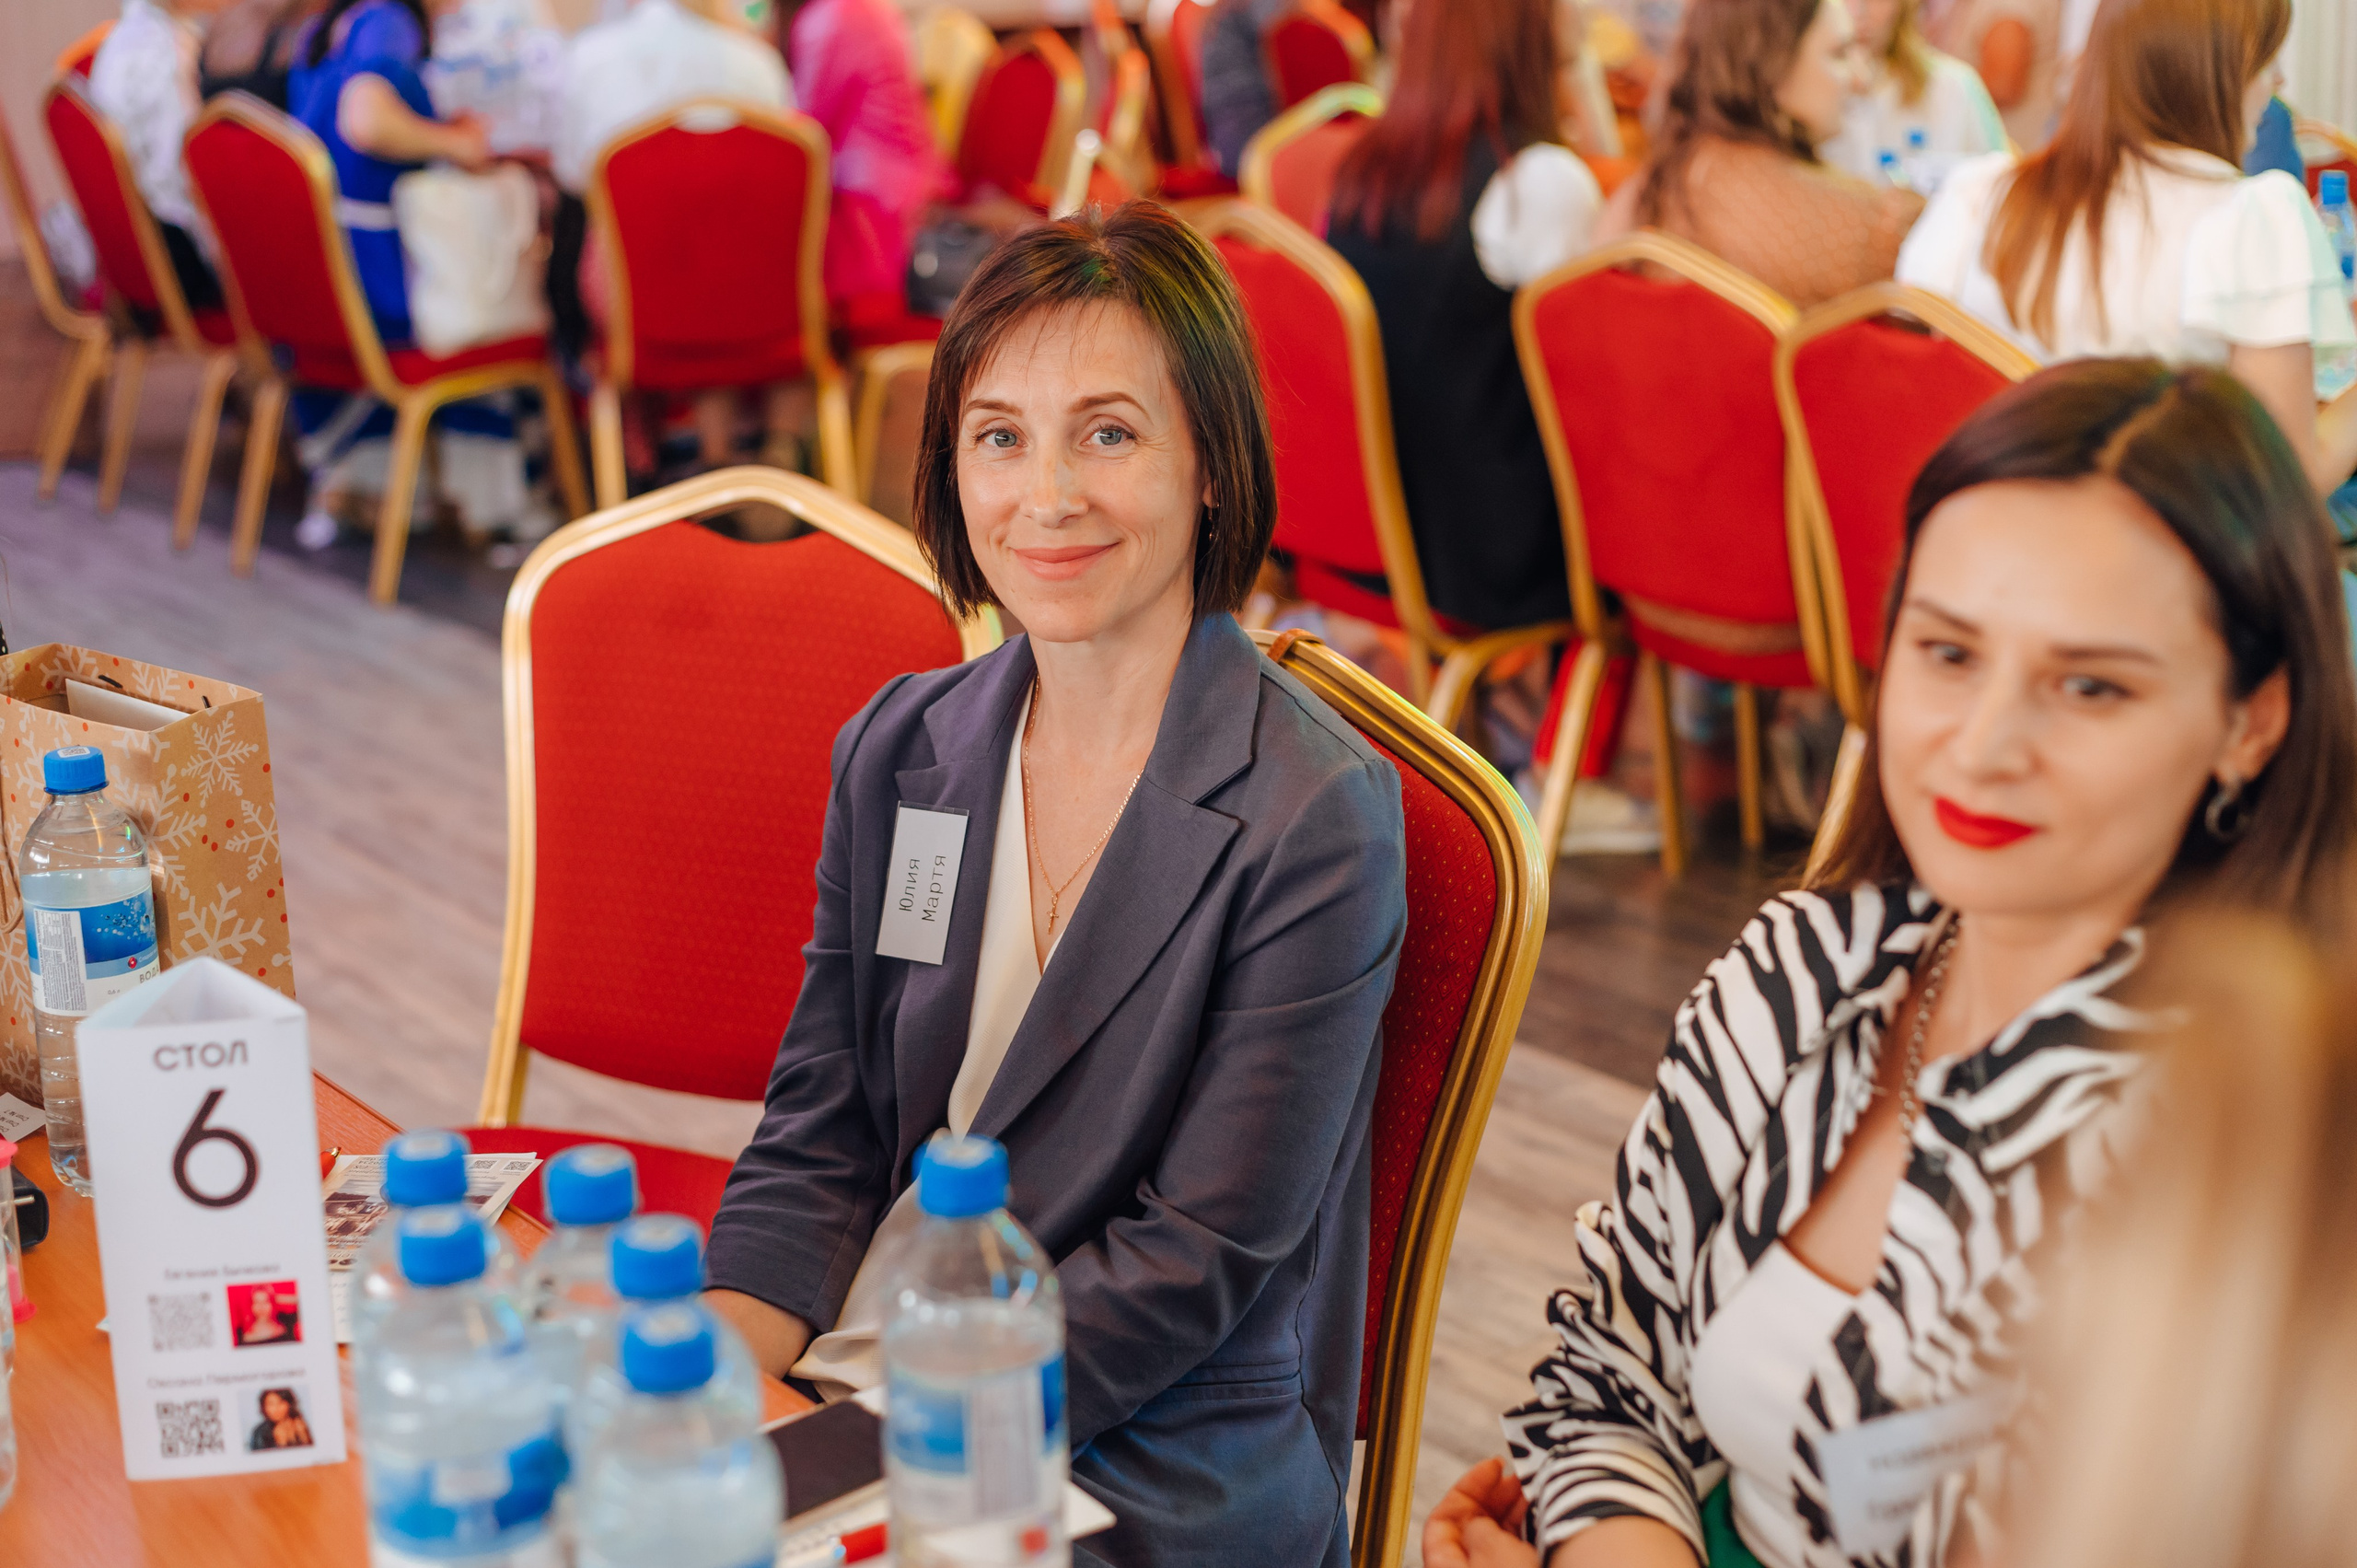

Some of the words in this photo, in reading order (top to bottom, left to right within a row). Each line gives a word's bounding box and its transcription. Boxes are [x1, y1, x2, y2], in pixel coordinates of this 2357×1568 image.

[899, 858, 921, 912] Юлия
[921, 855, 946, 922] Мартя
[153, 1040, 249, 1072] СТОЛ
[172, 1086, 260, 1210] 6
